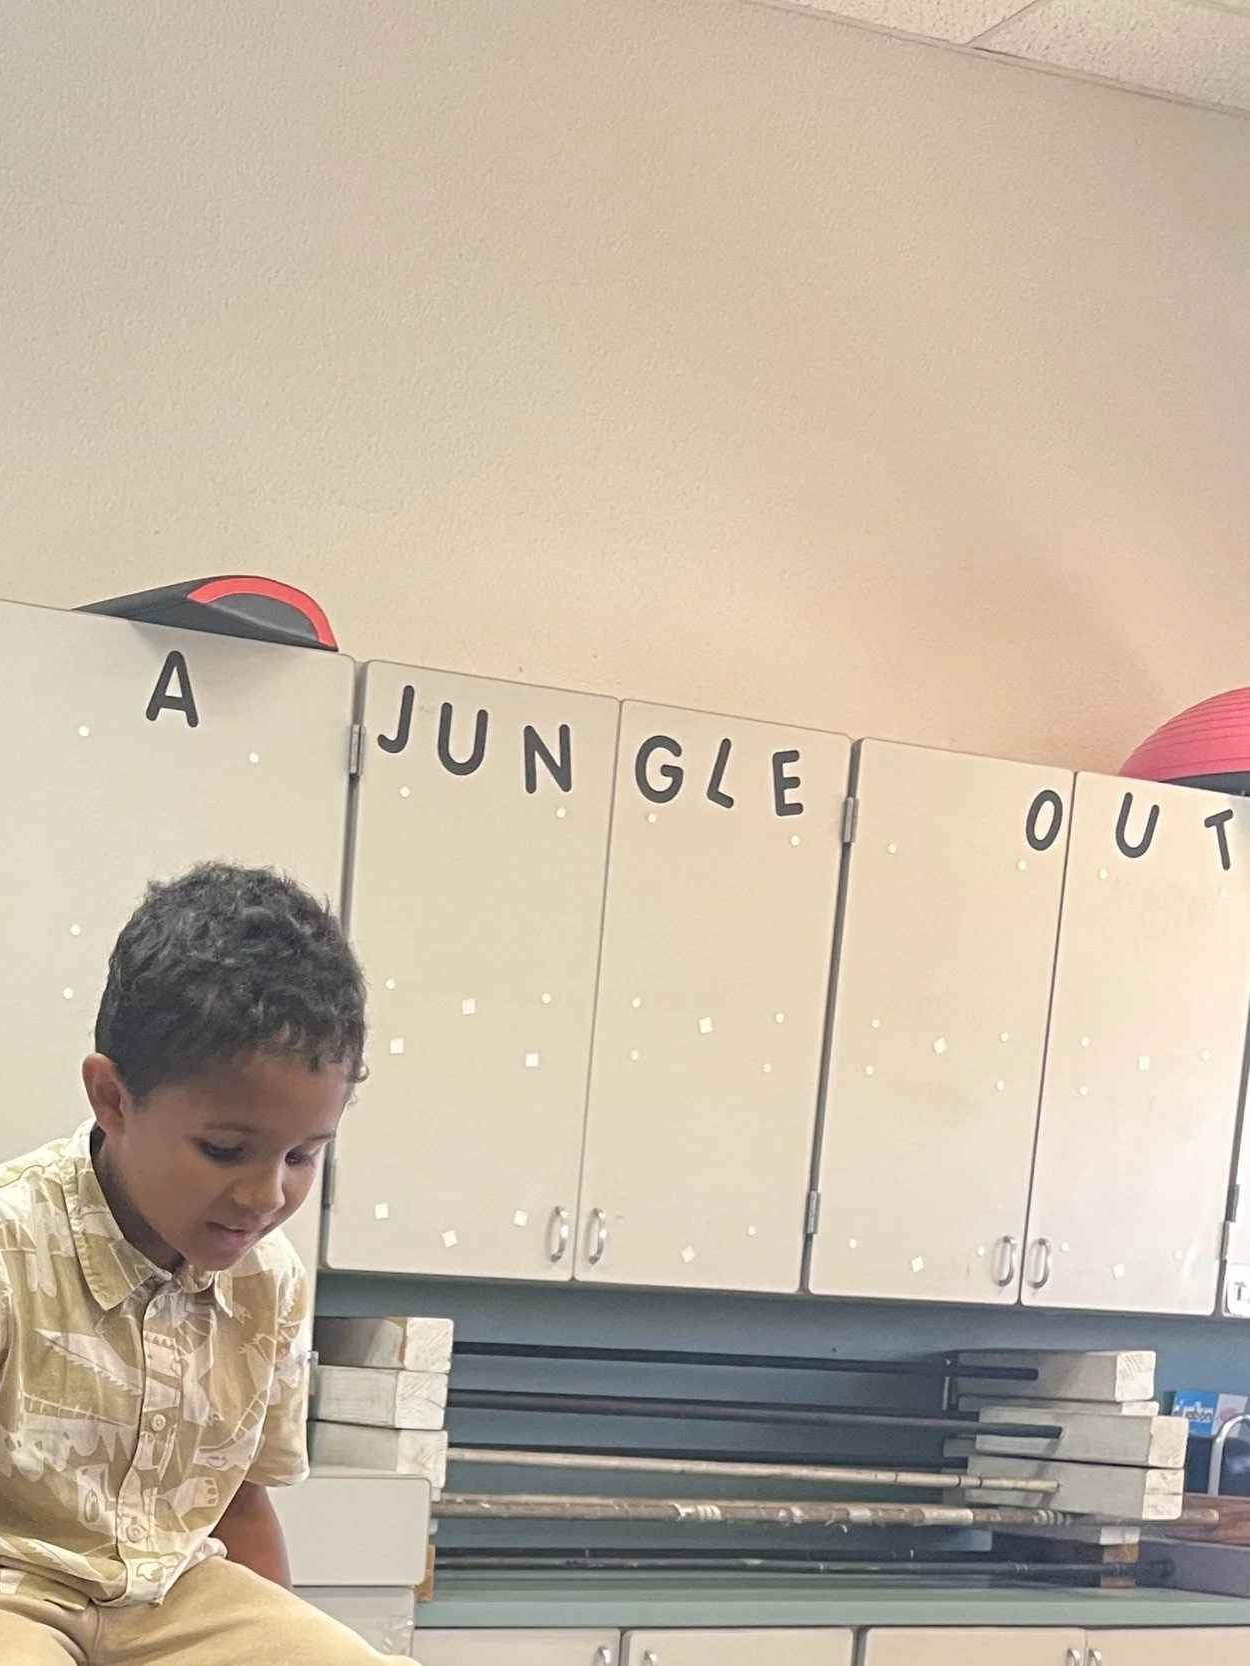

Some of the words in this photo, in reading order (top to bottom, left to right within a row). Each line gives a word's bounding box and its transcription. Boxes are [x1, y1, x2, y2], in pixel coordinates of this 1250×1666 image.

[144, 649, 200, 728] A
[377, 684, 805, 818] JUNGLE
[1025, 789, 1235, 872] OUT
